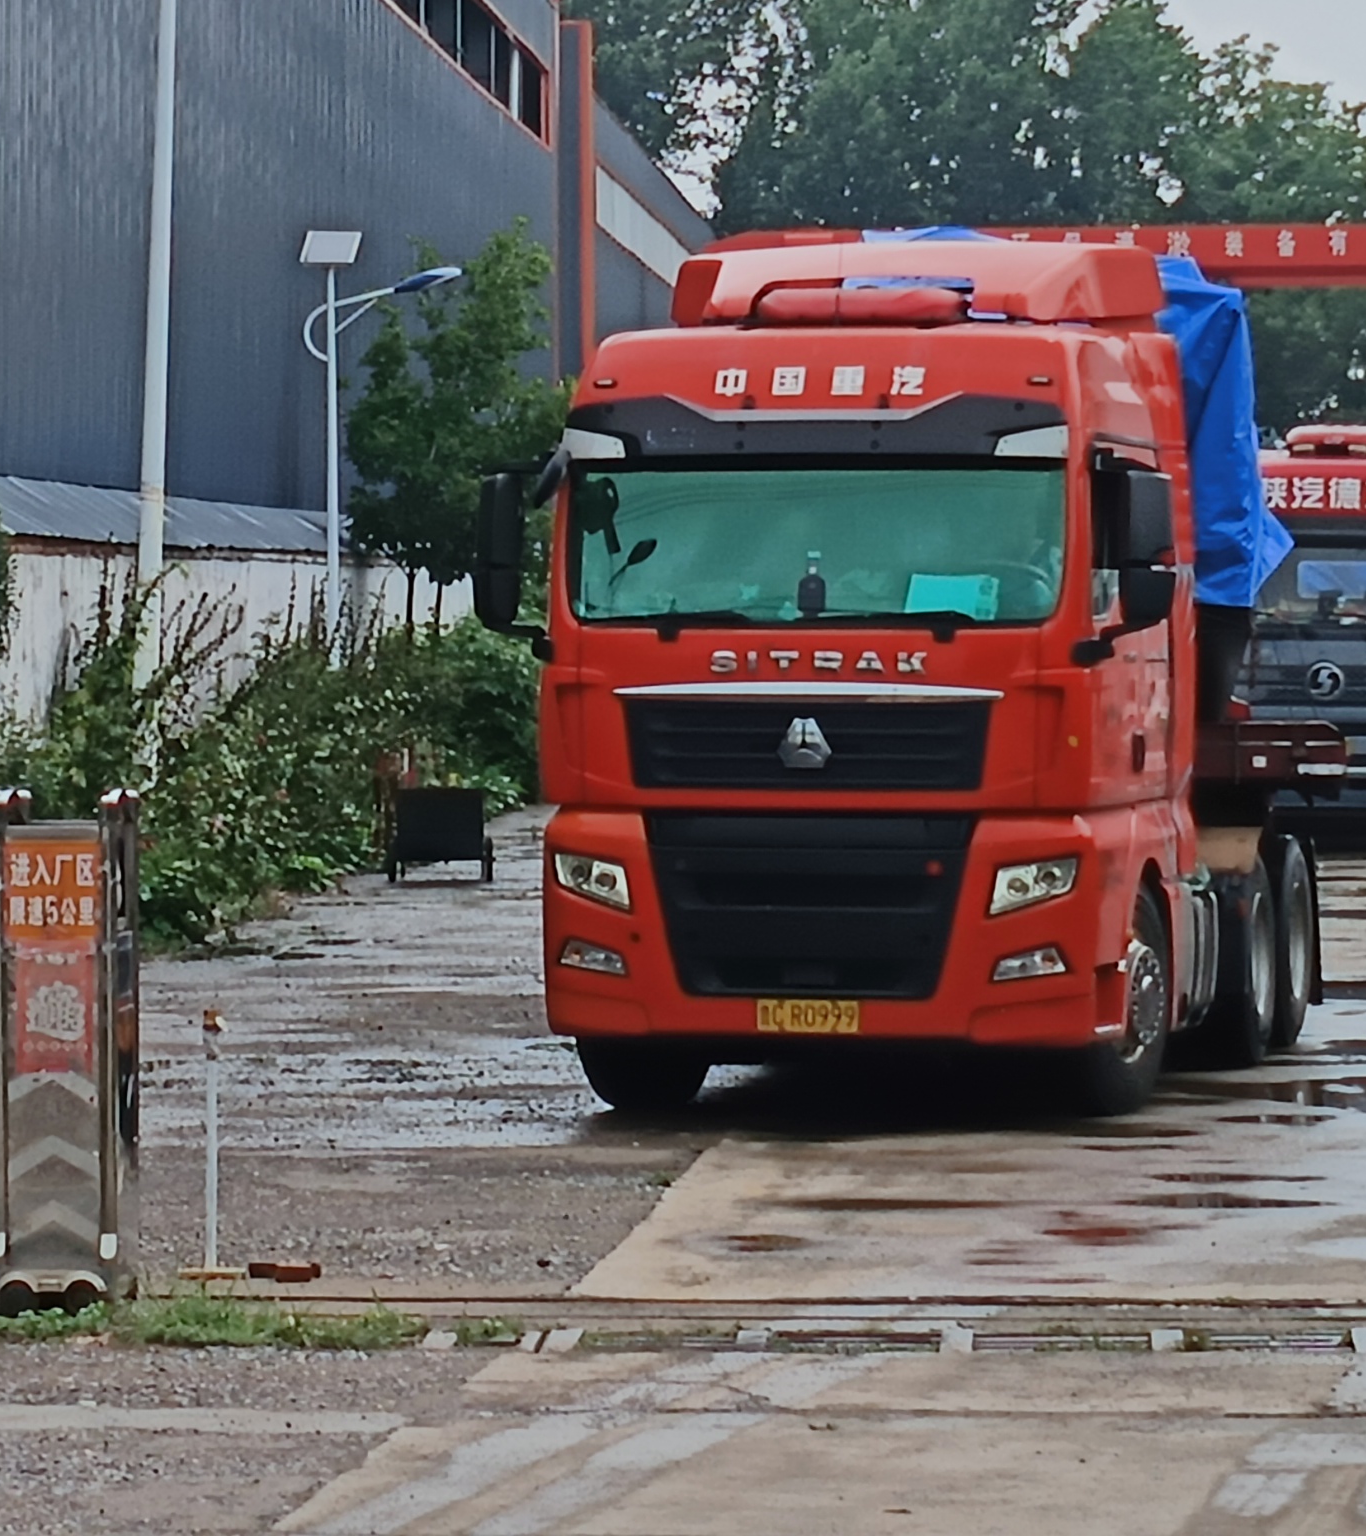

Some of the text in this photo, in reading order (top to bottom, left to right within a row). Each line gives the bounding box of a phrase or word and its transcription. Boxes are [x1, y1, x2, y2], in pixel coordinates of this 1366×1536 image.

[714, 366, 926, 397] 中国重汽
[709, 649, 928, 675] SITRAK
[10, 852, 95, 887] 进入厂区
[9, 895, 95, 926] 限速5公里
